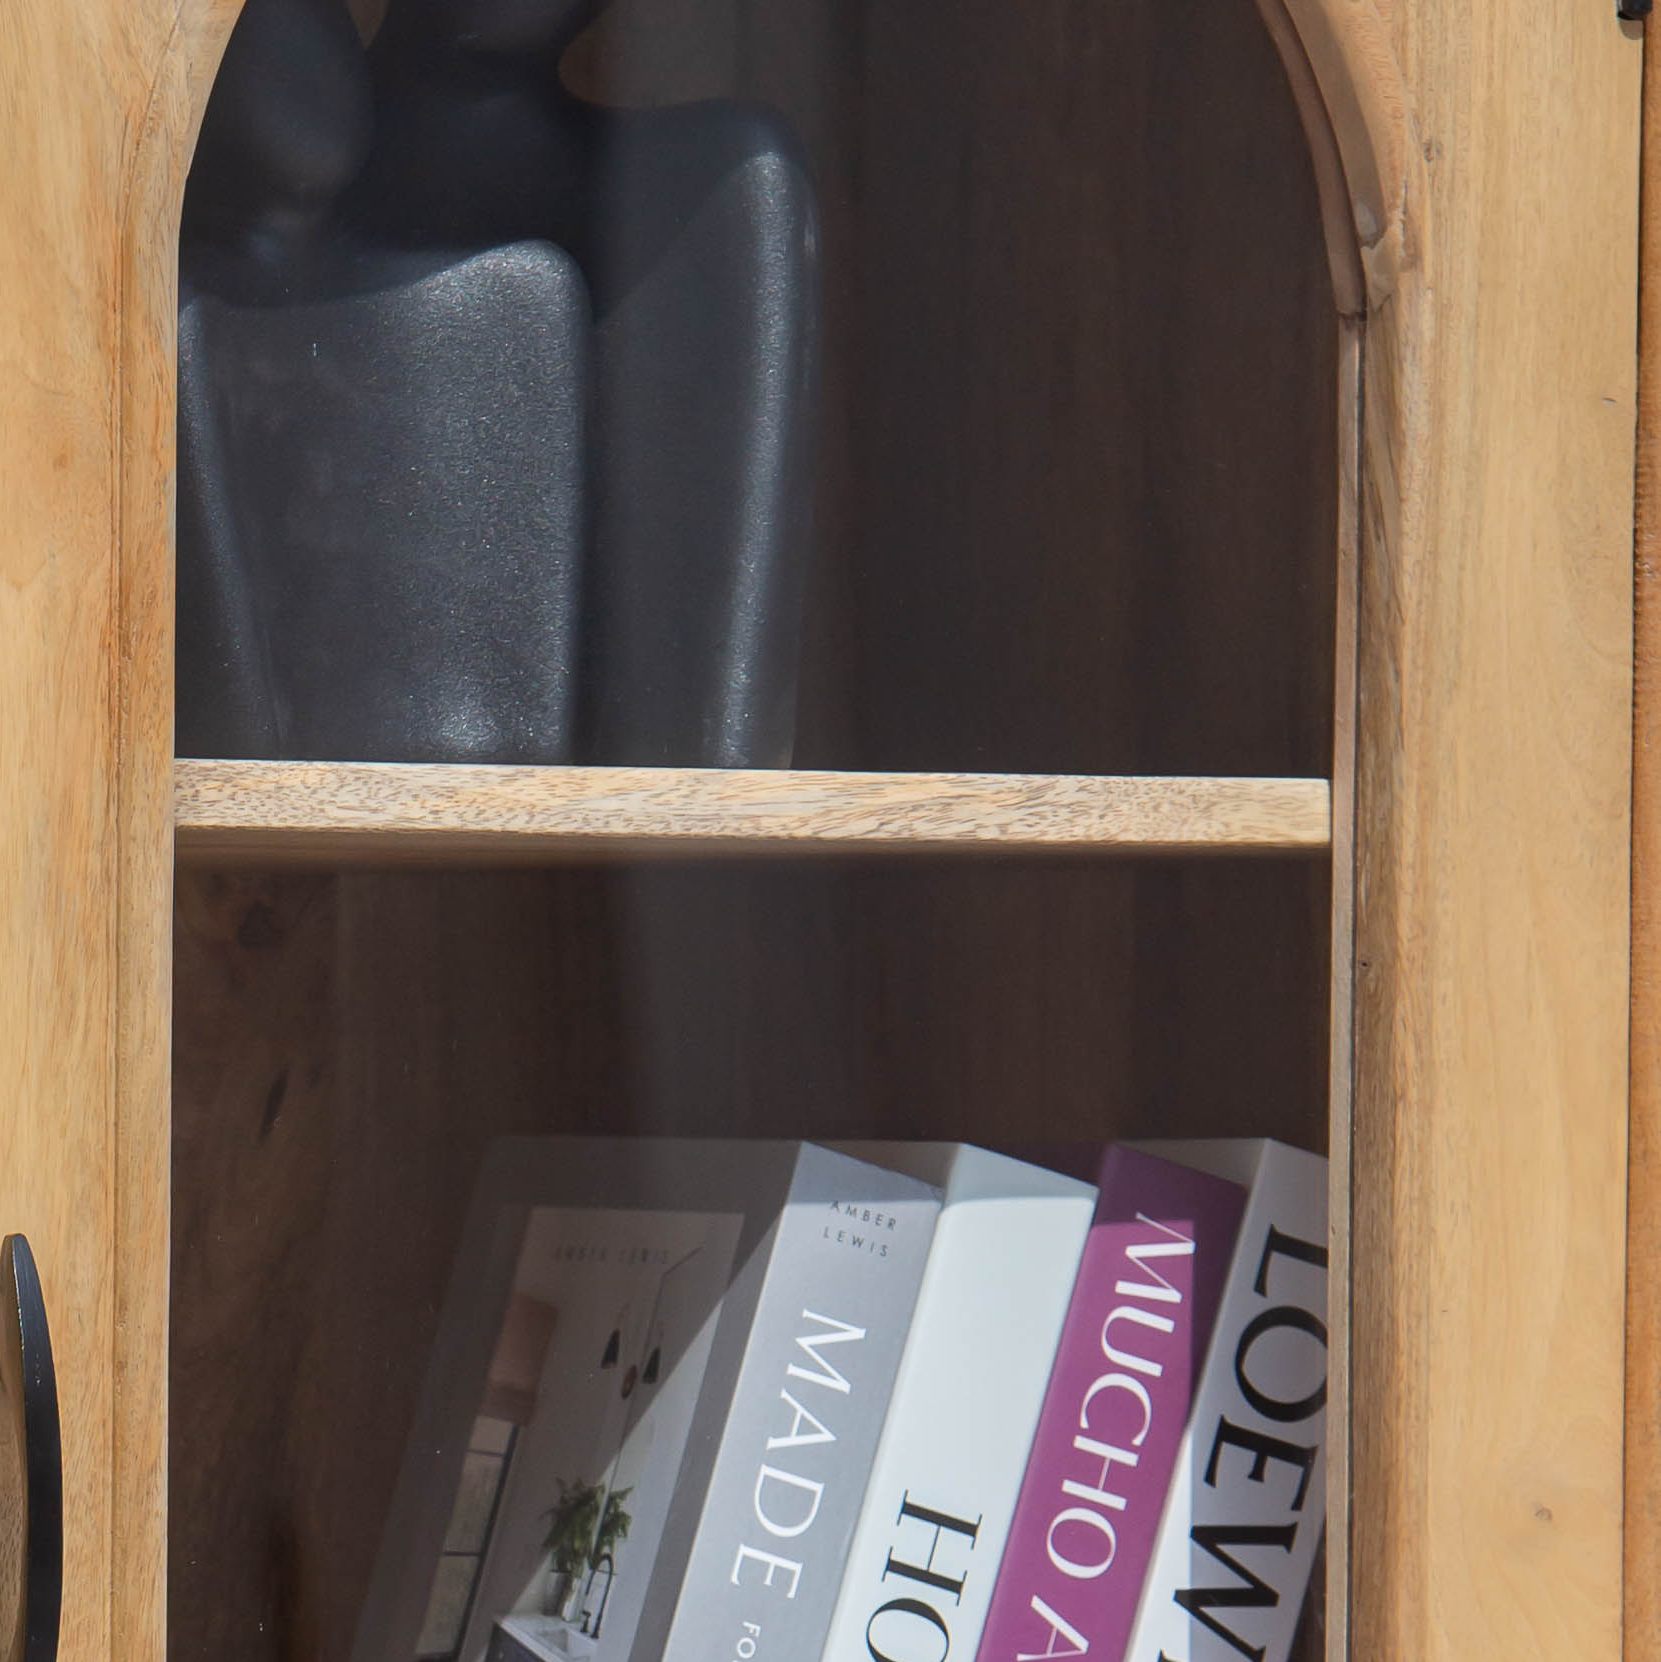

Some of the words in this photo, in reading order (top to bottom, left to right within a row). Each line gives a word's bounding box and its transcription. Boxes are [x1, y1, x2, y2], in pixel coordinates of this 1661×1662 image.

[823, 1226, 889, 1257] LEWIS
[829, 1200, 897, 1231] AMBER
[730, 1308, 867, 1599] MADE
[1046, 1211, 1196, 1580] MUCHO
